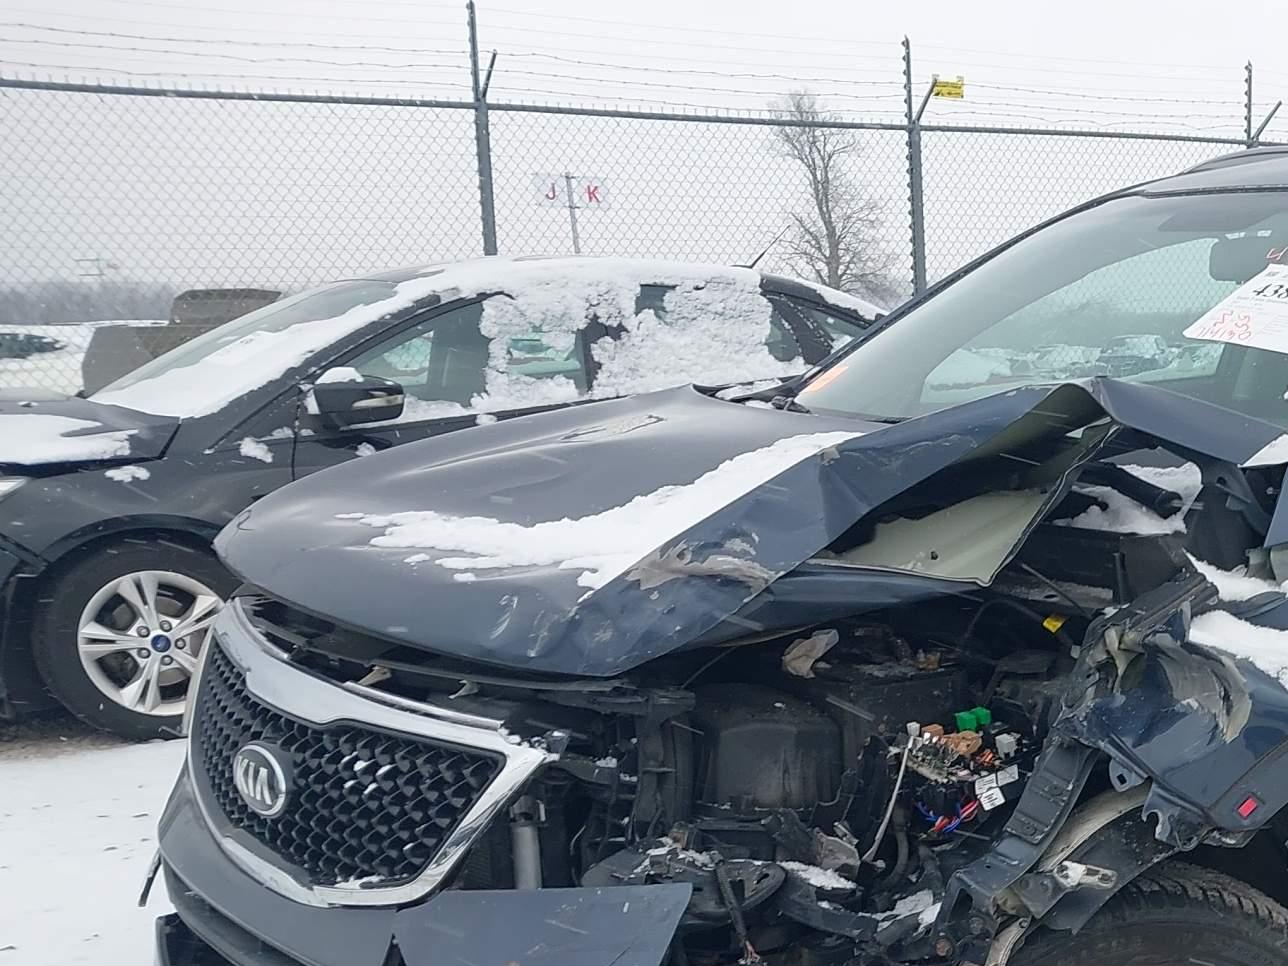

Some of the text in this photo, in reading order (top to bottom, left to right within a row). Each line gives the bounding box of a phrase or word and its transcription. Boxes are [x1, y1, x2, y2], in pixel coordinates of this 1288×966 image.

[545, 182, 601, 203] J K
[236, 755, 273, 806] KIA
